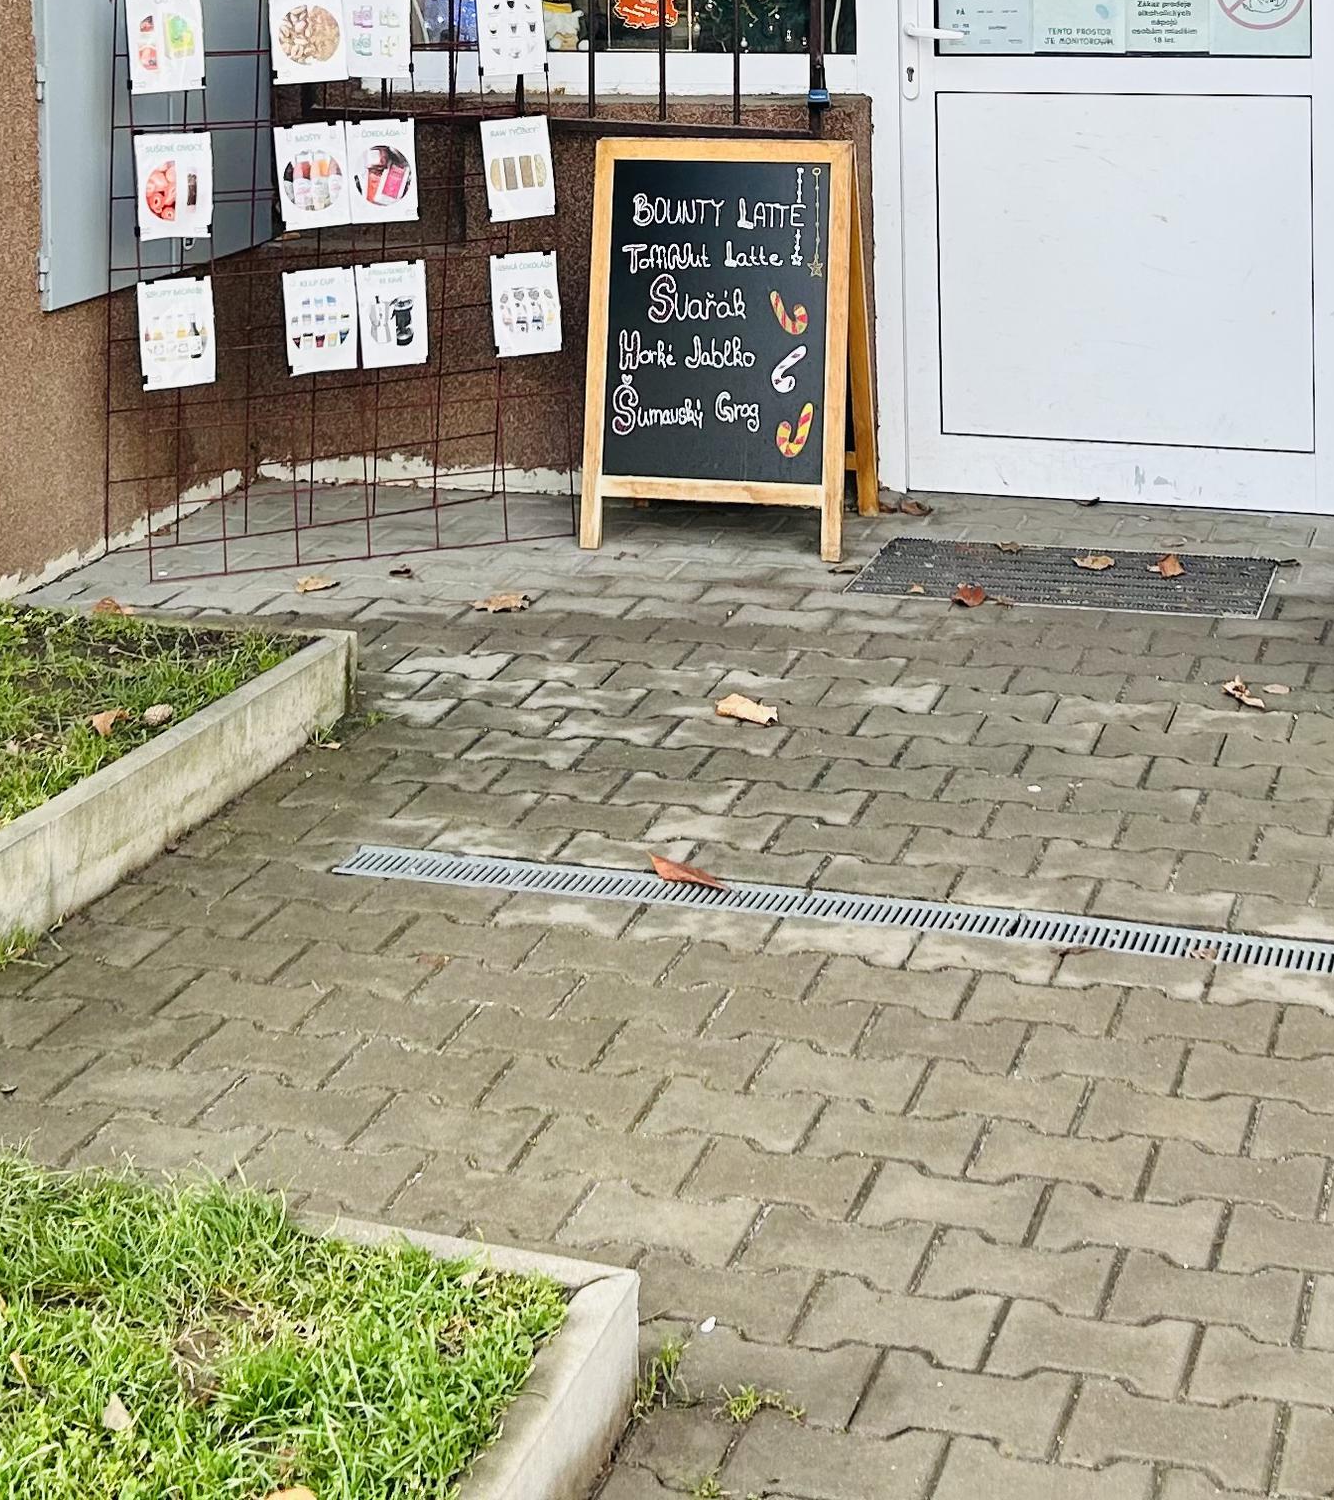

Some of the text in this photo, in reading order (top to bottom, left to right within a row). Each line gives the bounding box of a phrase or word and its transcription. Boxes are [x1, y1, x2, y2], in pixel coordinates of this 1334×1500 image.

[1044, 37, 1056, 45] JE
[631, 192, 807, 230] BOUNTY LATTE
[725, 241, 784, 268] Latte
[648, 273, 747, 324] Svařák
[619, 330, 757, 370] Horké Jablko
[612, 373, 761, 436] Šumavský Grog
